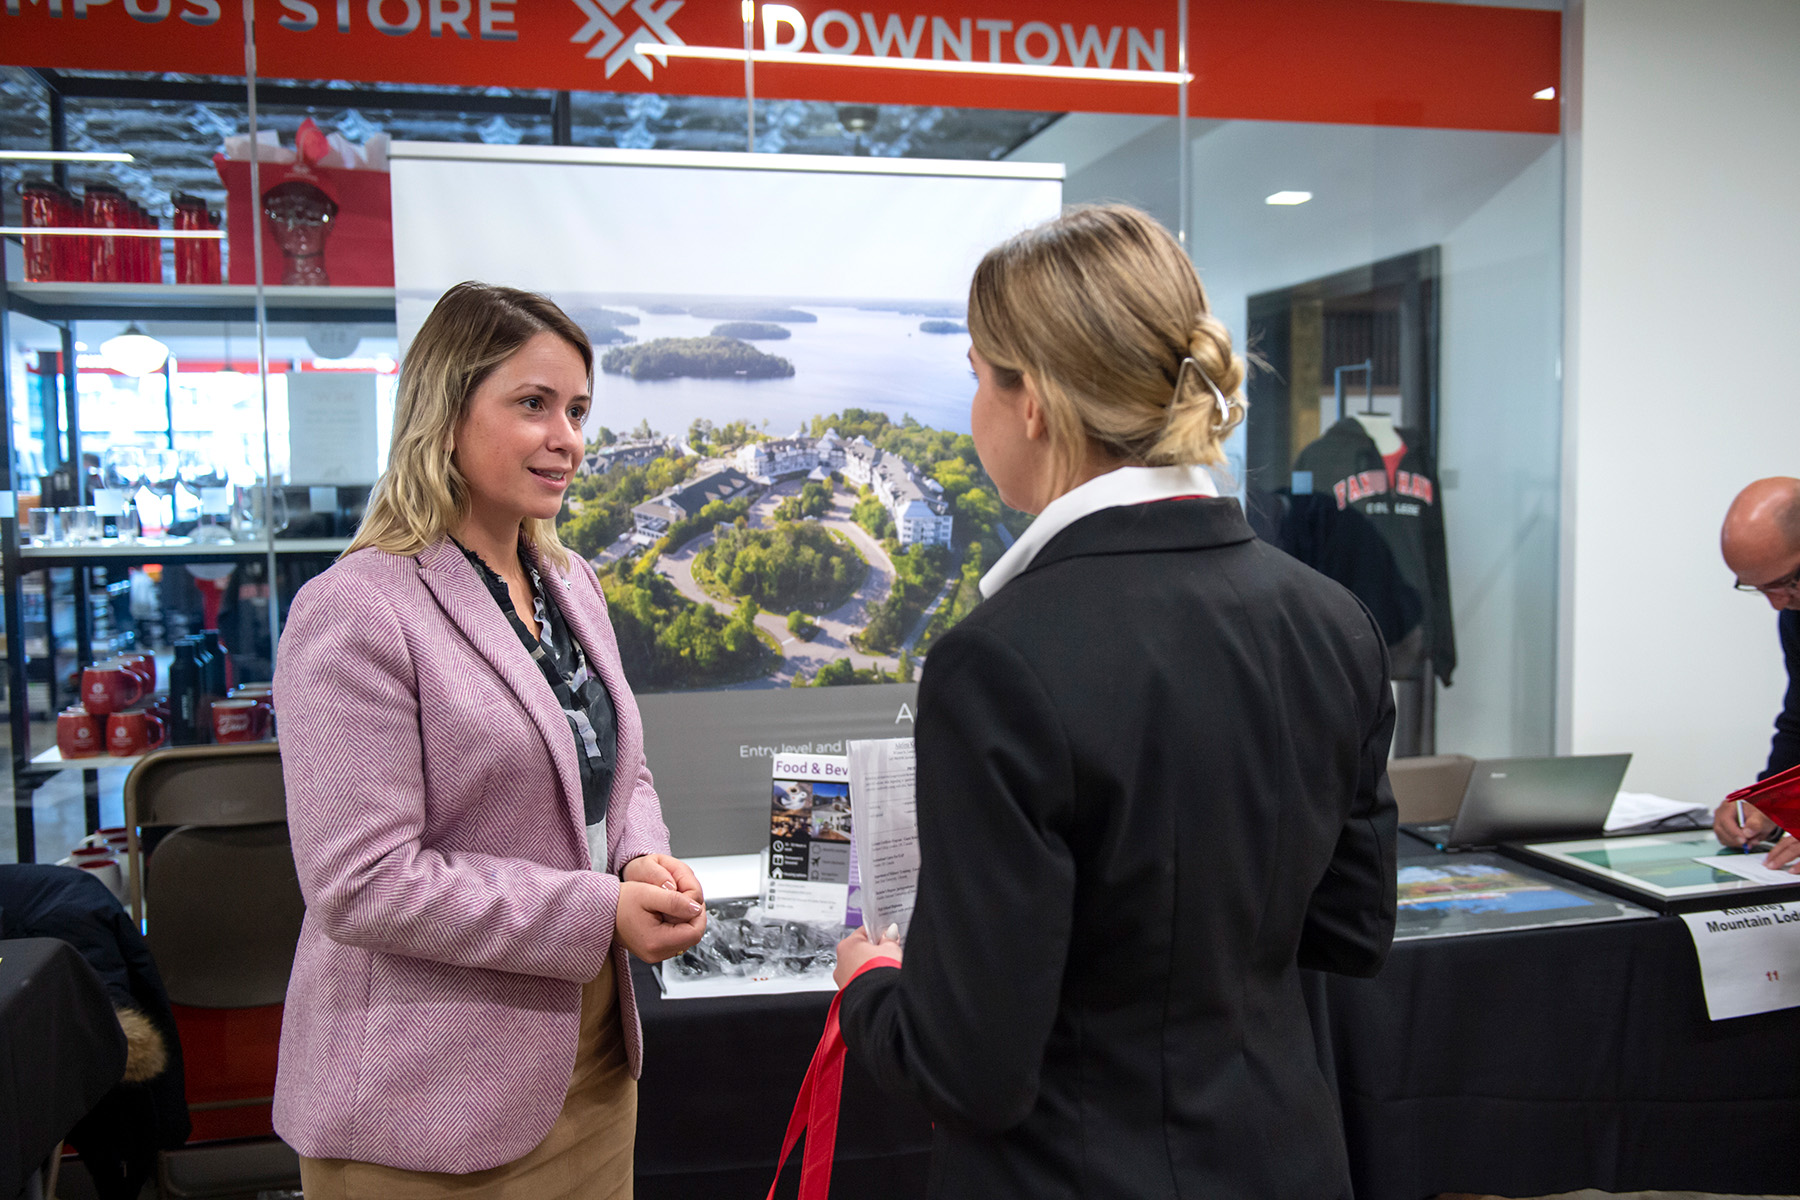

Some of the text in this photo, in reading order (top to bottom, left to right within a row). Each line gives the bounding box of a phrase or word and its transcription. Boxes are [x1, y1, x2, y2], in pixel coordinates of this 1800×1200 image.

[277, 0, 519, 42] STORE
[762, 4, 1166, 72] DOWNTOWN
[740, 741, 842, 758] Entry level and
[776, 761, 808, 774] Food
[811, 763, 821, 774] &
[1706, 915, 1773, 933] Mountain
